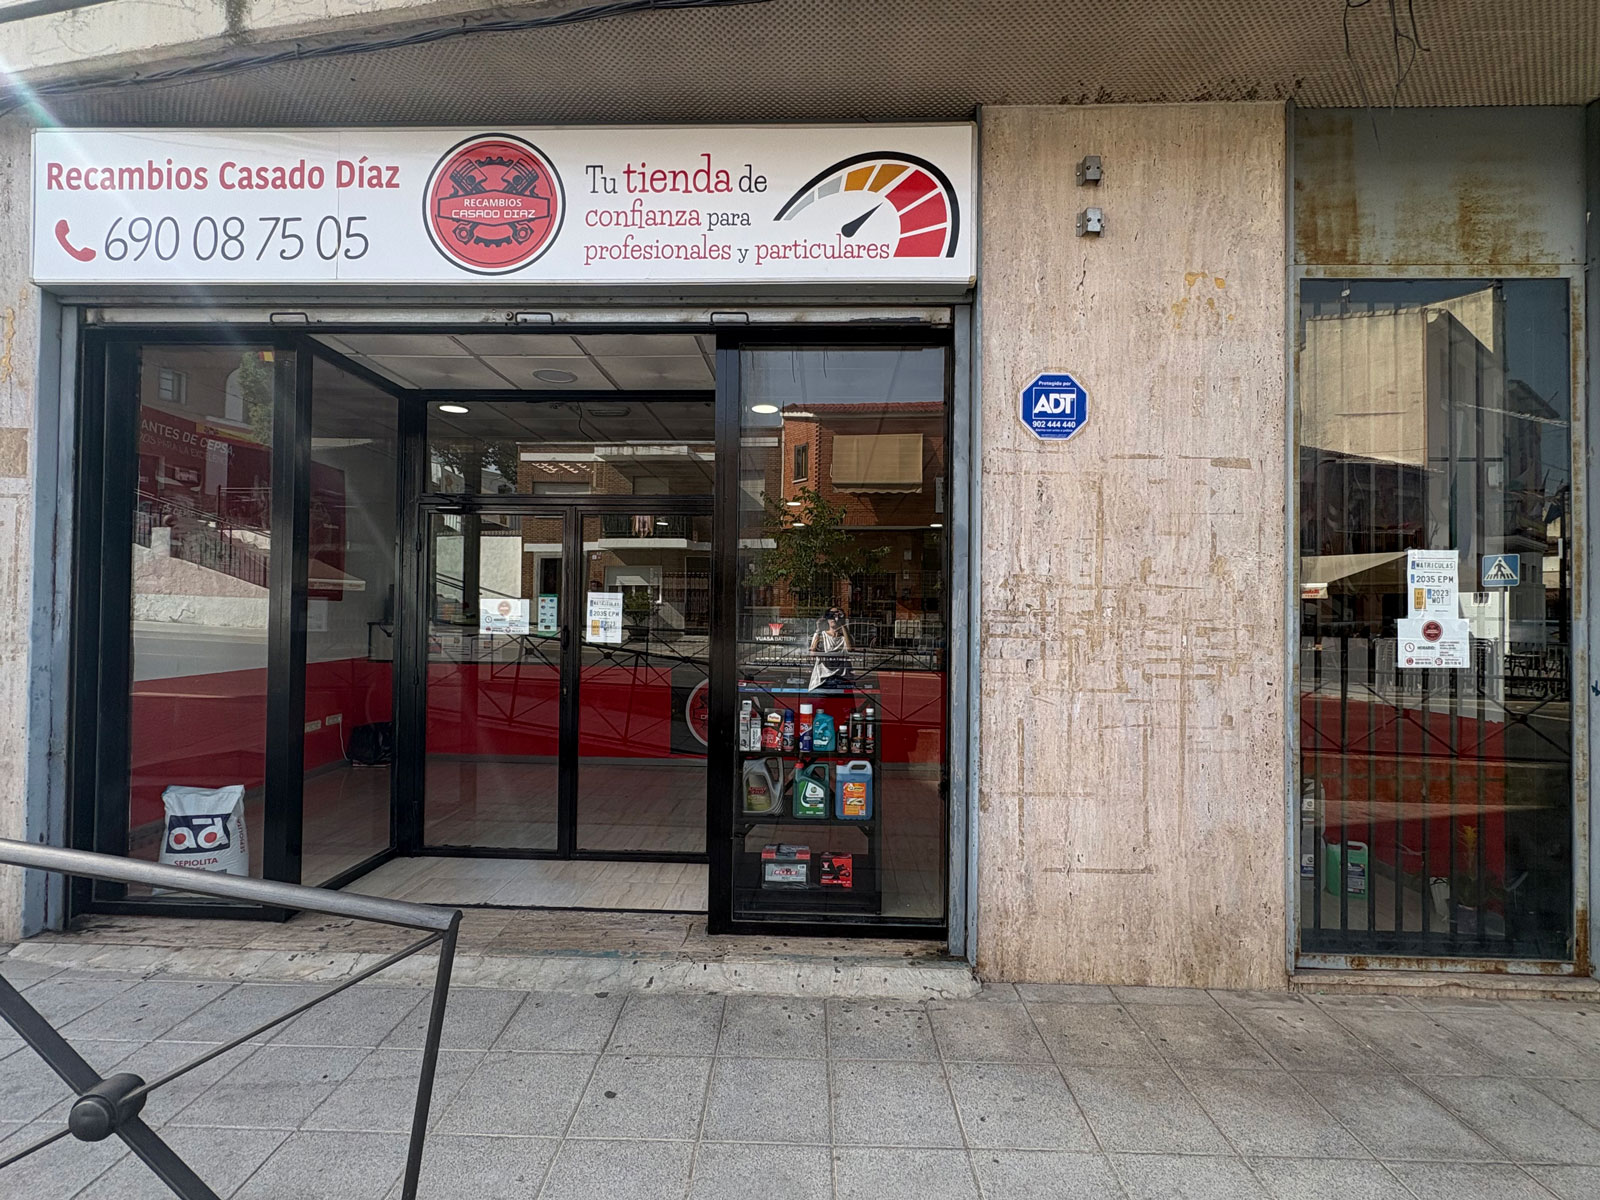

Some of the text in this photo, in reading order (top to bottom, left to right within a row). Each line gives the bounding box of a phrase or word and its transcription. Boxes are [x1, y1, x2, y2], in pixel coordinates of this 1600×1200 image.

[47, 156, 400, 191] Recambios Casado Díaz
[585, 152, 767, 194] Tu tienda de
[463, 198, 522, 207] RECAMBIOS
[452, 210, 536, 218] CASADO DIAZ
[585, 198, 752, 232] confianza para
[104, 215, 369, 262] 690 08 75 05
[584, 230, 890, 266] profesionales y particulares
[1033, 393, 1076, 414] ADT
[182, 432, 198, 446] DE
[1416, 575, 1454, 584] 2035 EPM
[1432, 589, 1449, 597] 2023
[168, 817, 229, 851] ad
[174, 857, 218, 867] SEPIOLITA
